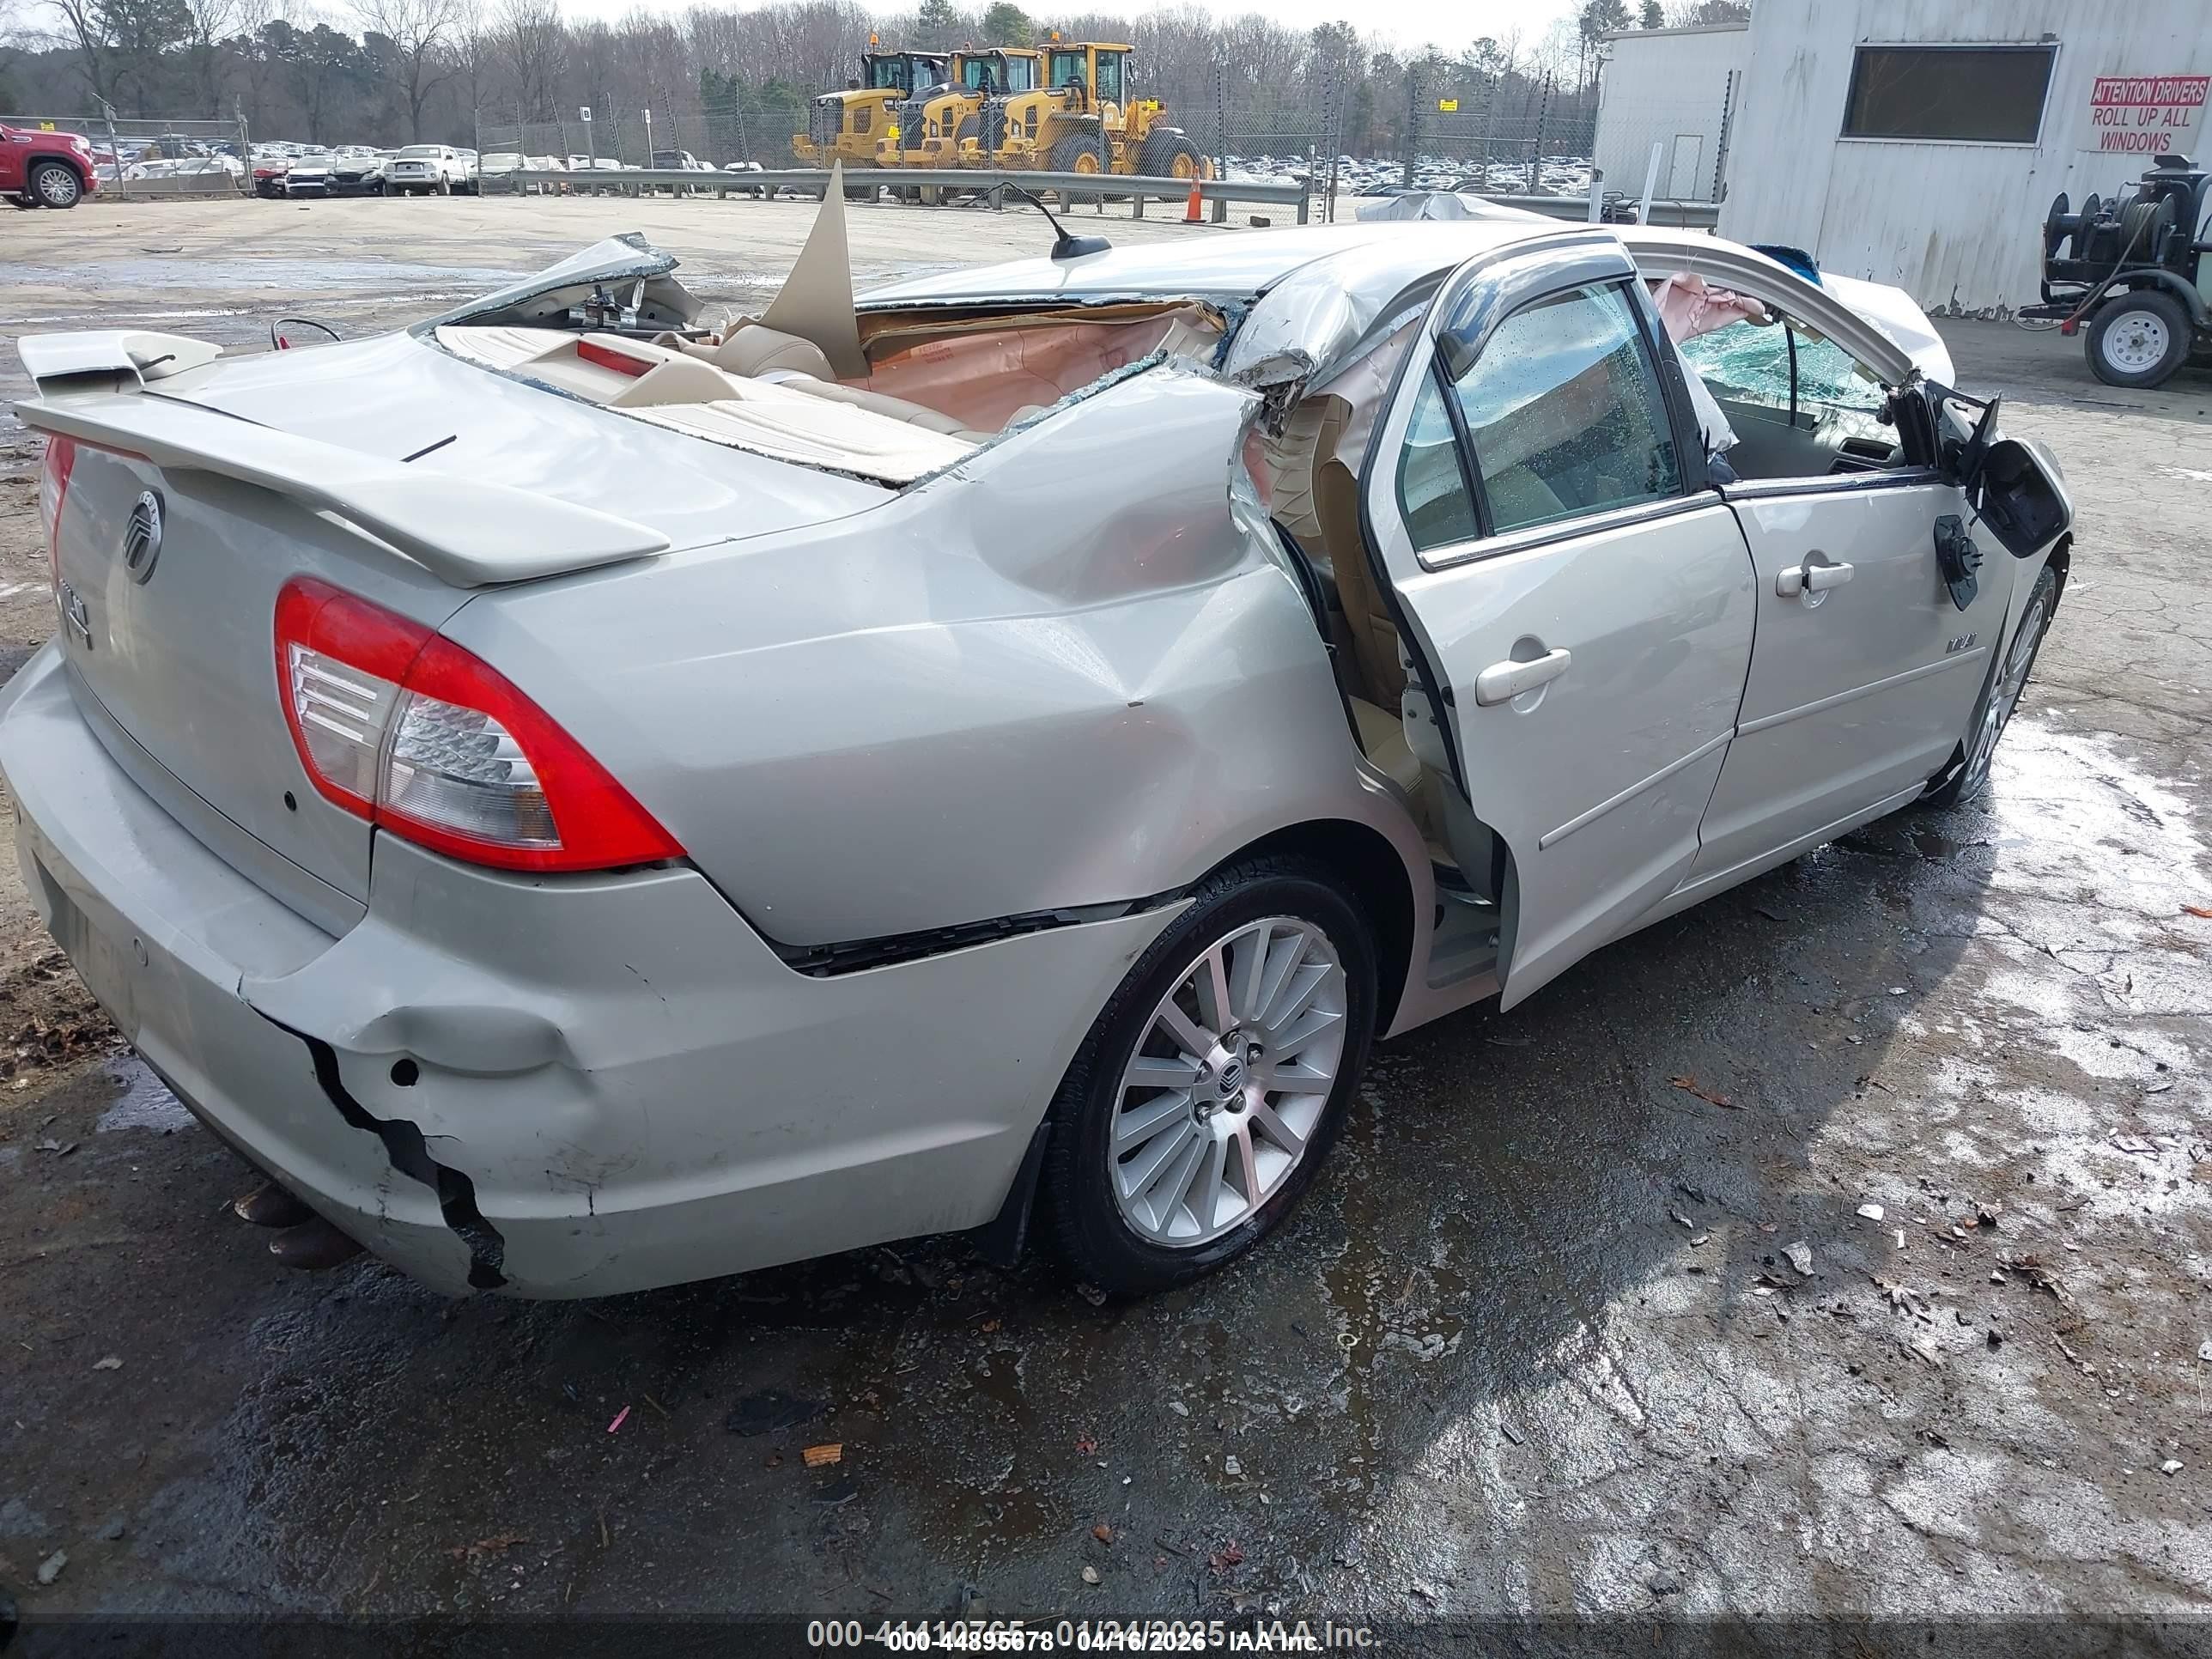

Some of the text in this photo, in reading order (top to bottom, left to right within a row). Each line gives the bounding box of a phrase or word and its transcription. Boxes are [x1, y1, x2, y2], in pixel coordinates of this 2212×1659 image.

[2093, 80, 2207, 103] ATTENTION DRIVERS
[956, 102, 963, 115] 33
[2092, 107, 2191, 127] ROLL UP ALL
[2100, 131, 2172, 151] WINDOWS
[137, 492, 158, 526] CURY
